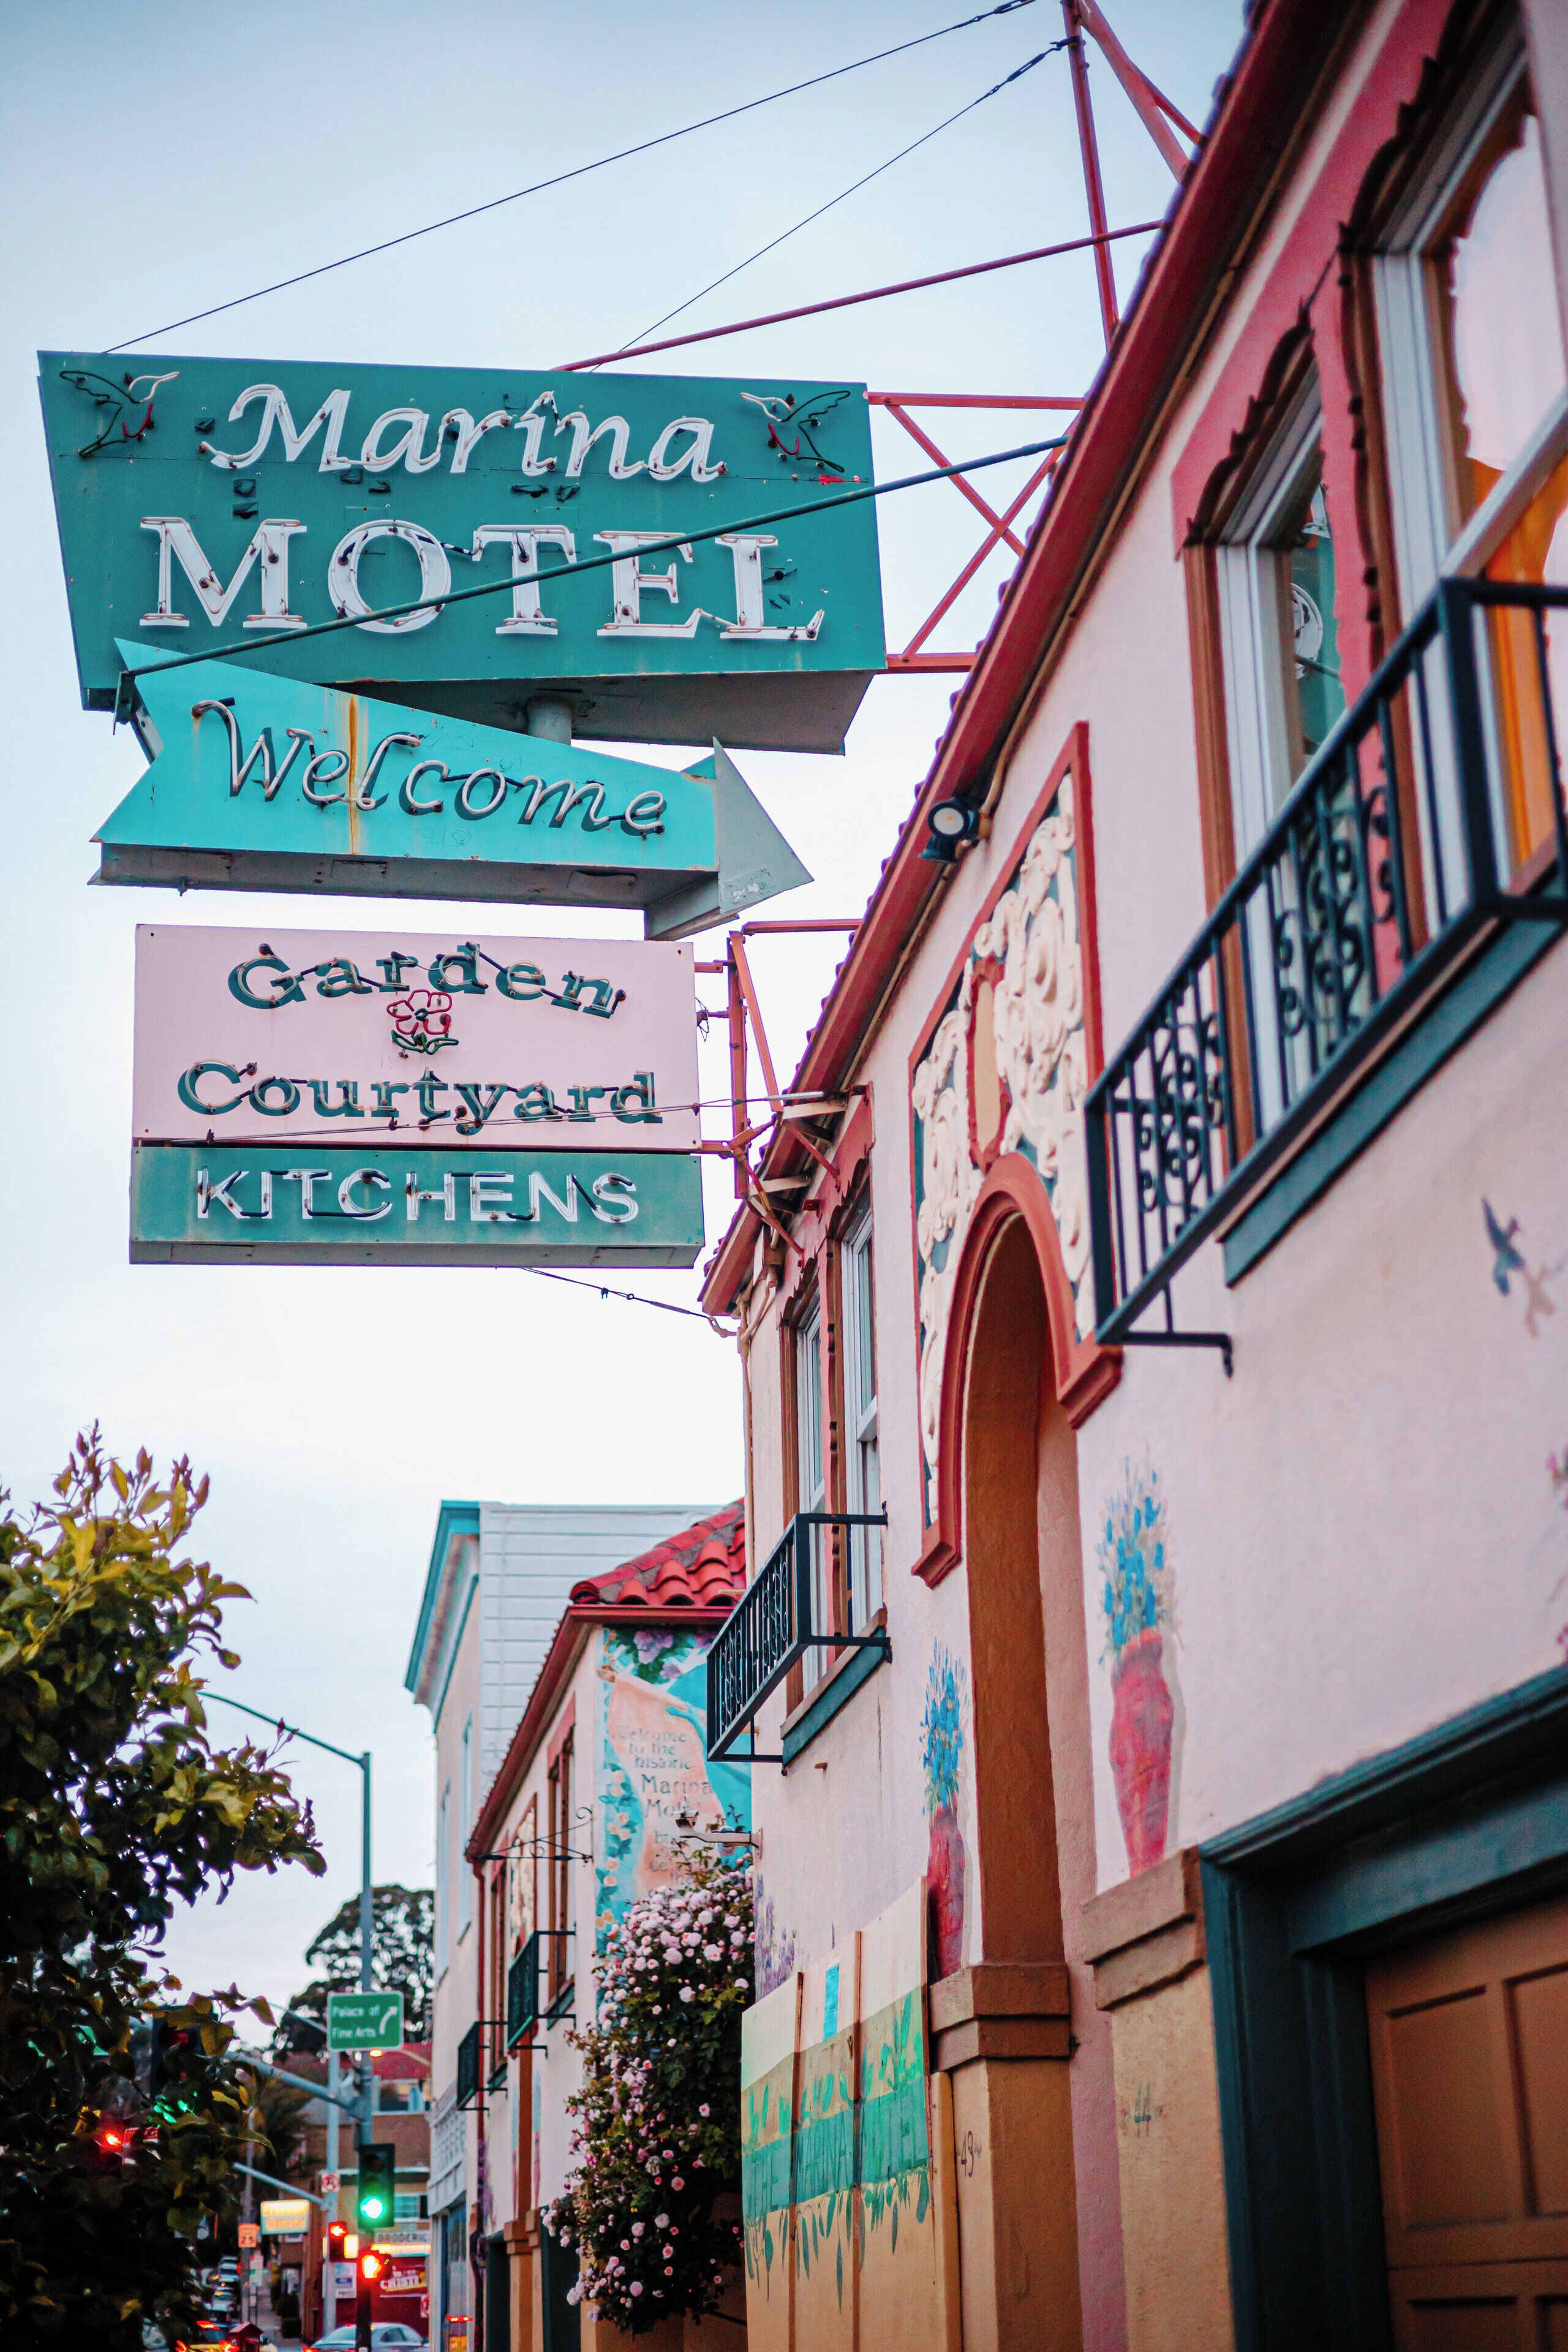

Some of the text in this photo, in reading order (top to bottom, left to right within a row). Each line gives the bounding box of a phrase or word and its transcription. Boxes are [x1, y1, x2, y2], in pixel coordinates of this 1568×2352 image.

[197, 385, 728, 482] Marina
[140, 518, 825, 641] MOTEL
[190, 696, 668, 837] Welcome
[228, 941, 624, 1018] Garden
[178, 1057, 663, 1136] Courtyard
[197, 1165, 639, 1223] KITCHENS
[641, 1774, 712, 1794] Marina
